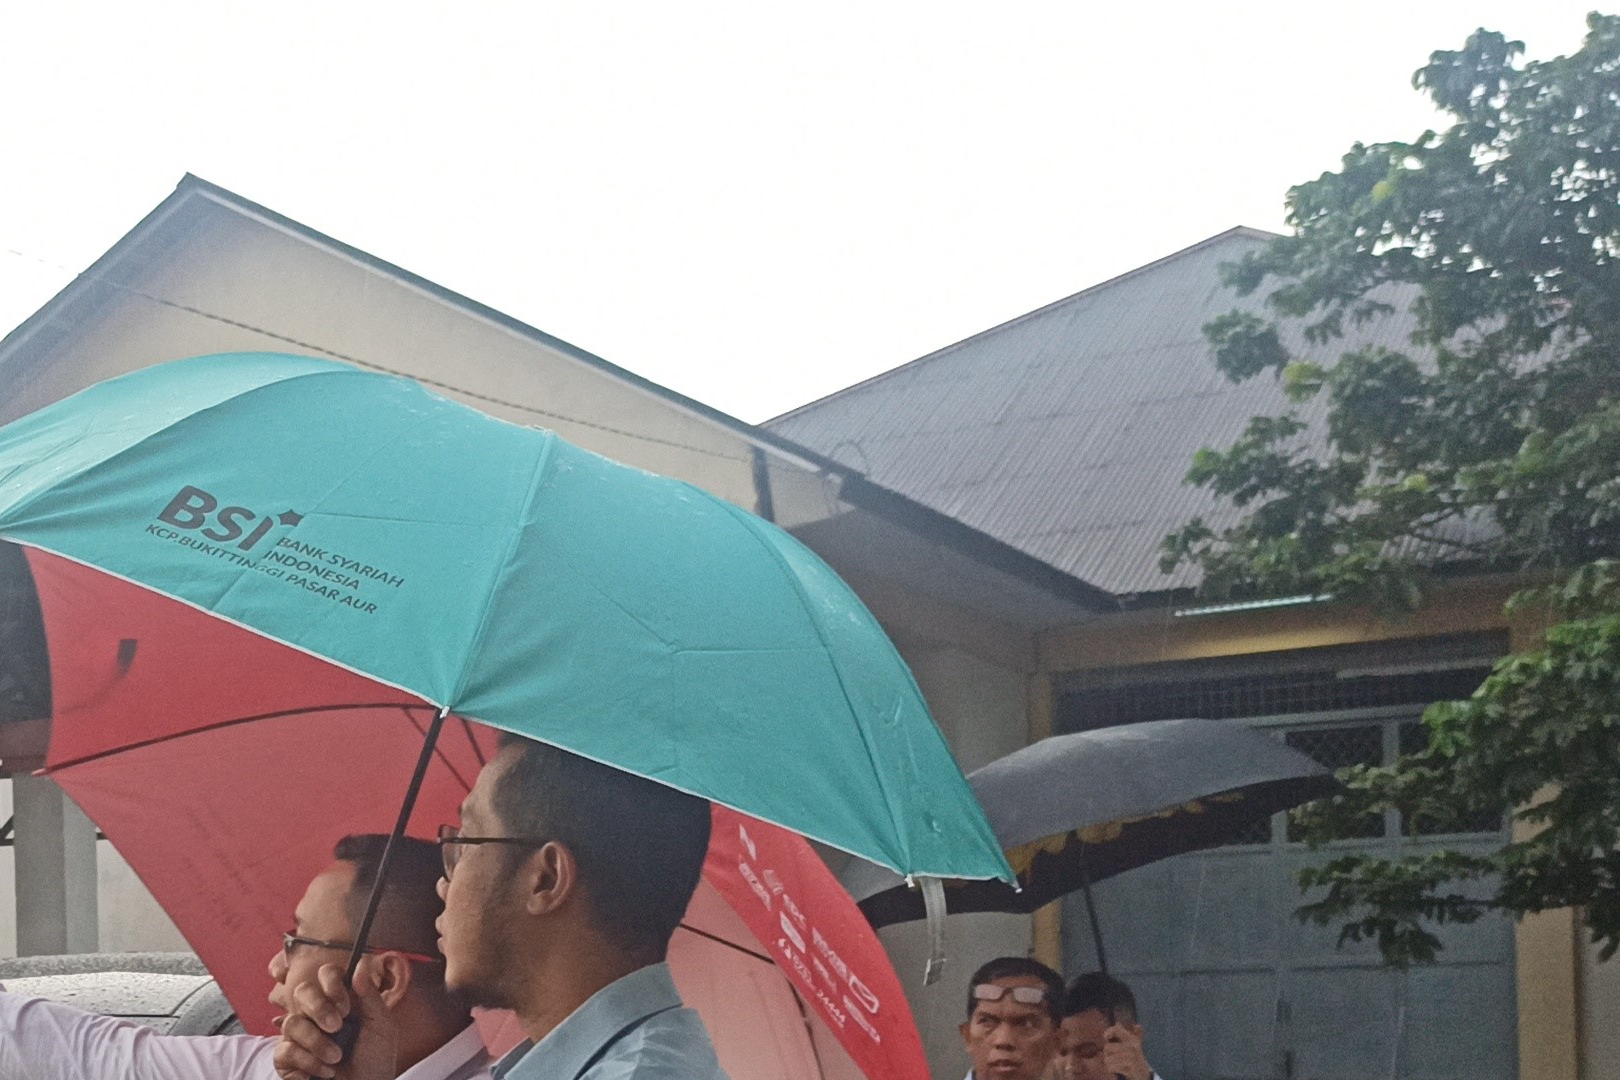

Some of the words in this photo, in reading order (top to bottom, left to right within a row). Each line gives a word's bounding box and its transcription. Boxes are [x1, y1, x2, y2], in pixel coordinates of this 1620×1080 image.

[156, 485, 274, 551] BSI
[263, 550, 360, 590] INDONESIA
[276, 536, 328, 560] BANK
[327, 554, 405, 588] SYARIAH
[285, 574, 340, 600] PASAR
[340, 595, 378, 614] AUR
